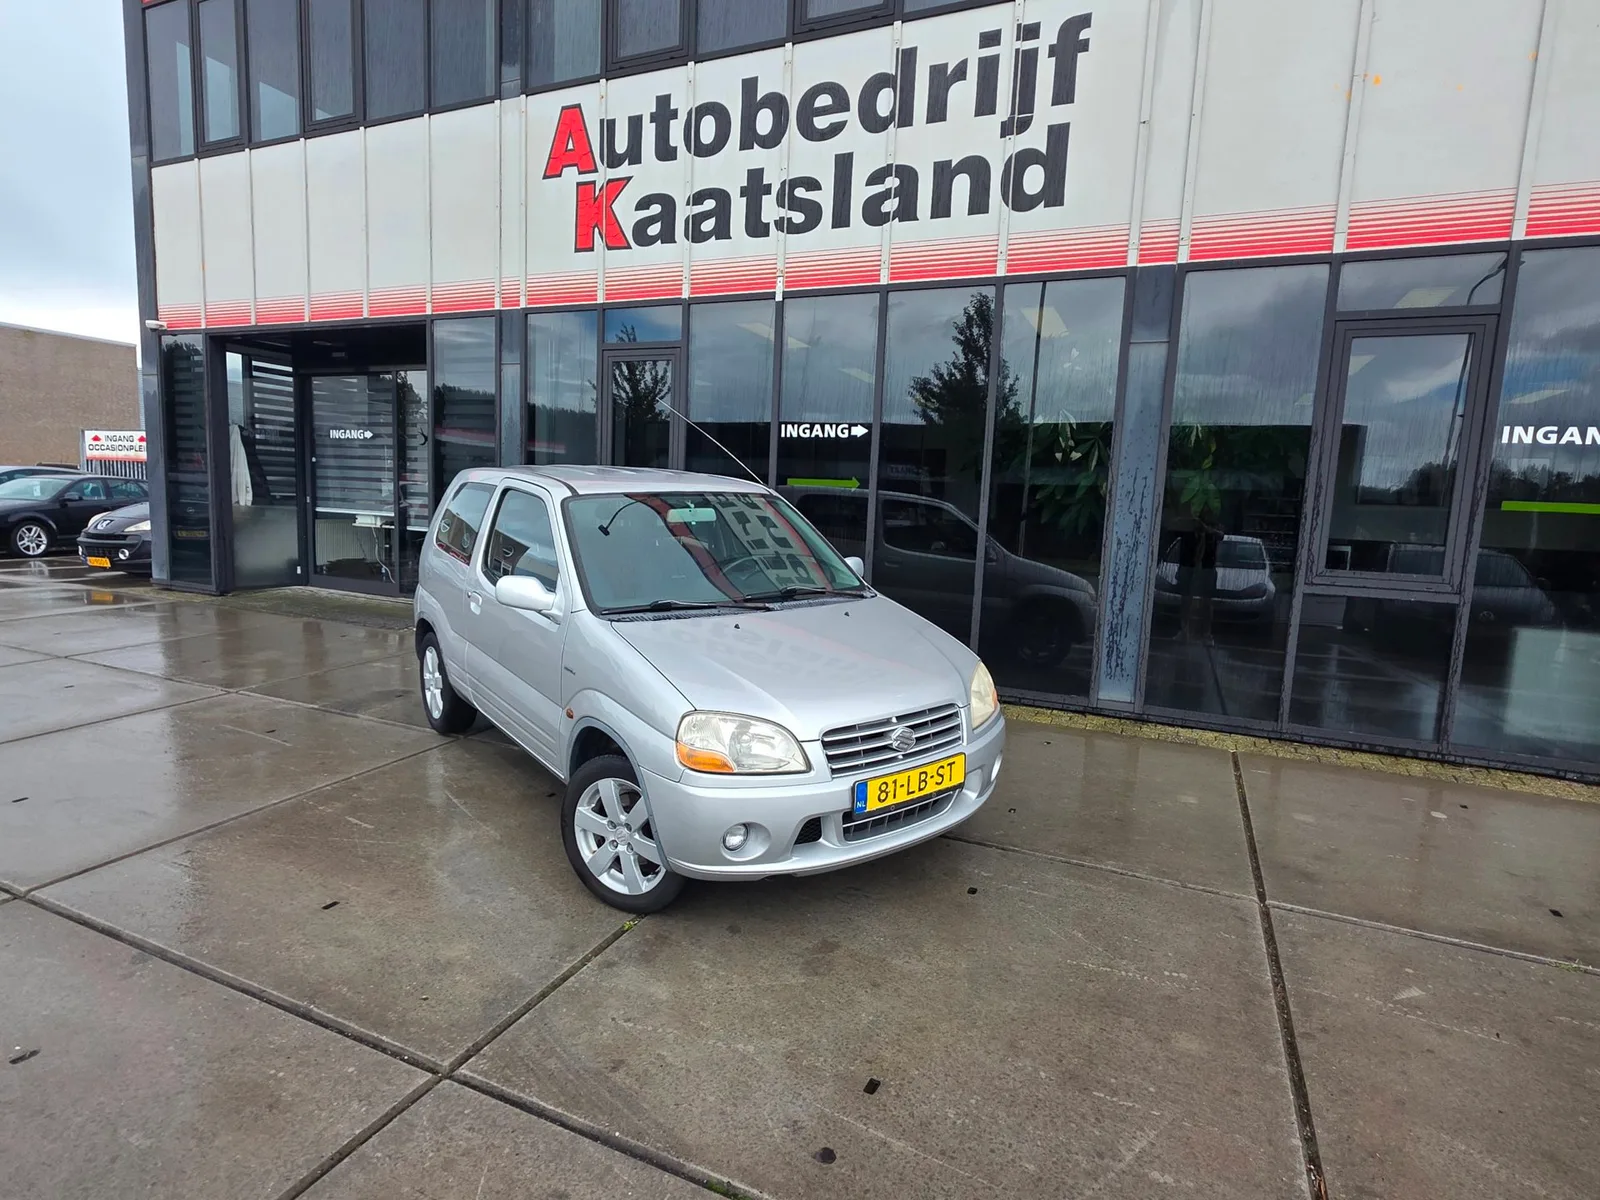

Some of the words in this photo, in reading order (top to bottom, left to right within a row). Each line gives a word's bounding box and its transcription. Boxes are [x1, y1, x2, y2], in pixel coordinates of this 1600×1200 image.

[542, 12, 1093, 180] Autobedrijf
[574, 122, 1071, 253] Kaatsland
[104, 434, 134, 442] INGANG
[329, 429, 364, 439] INGANG
[780, 423, 849, 438] INGANG
[1501, 425, 1600, 445] INGAN
[877, 762, 956, 803] 81-LB-ST
[856, 800, 866, 809] NL
